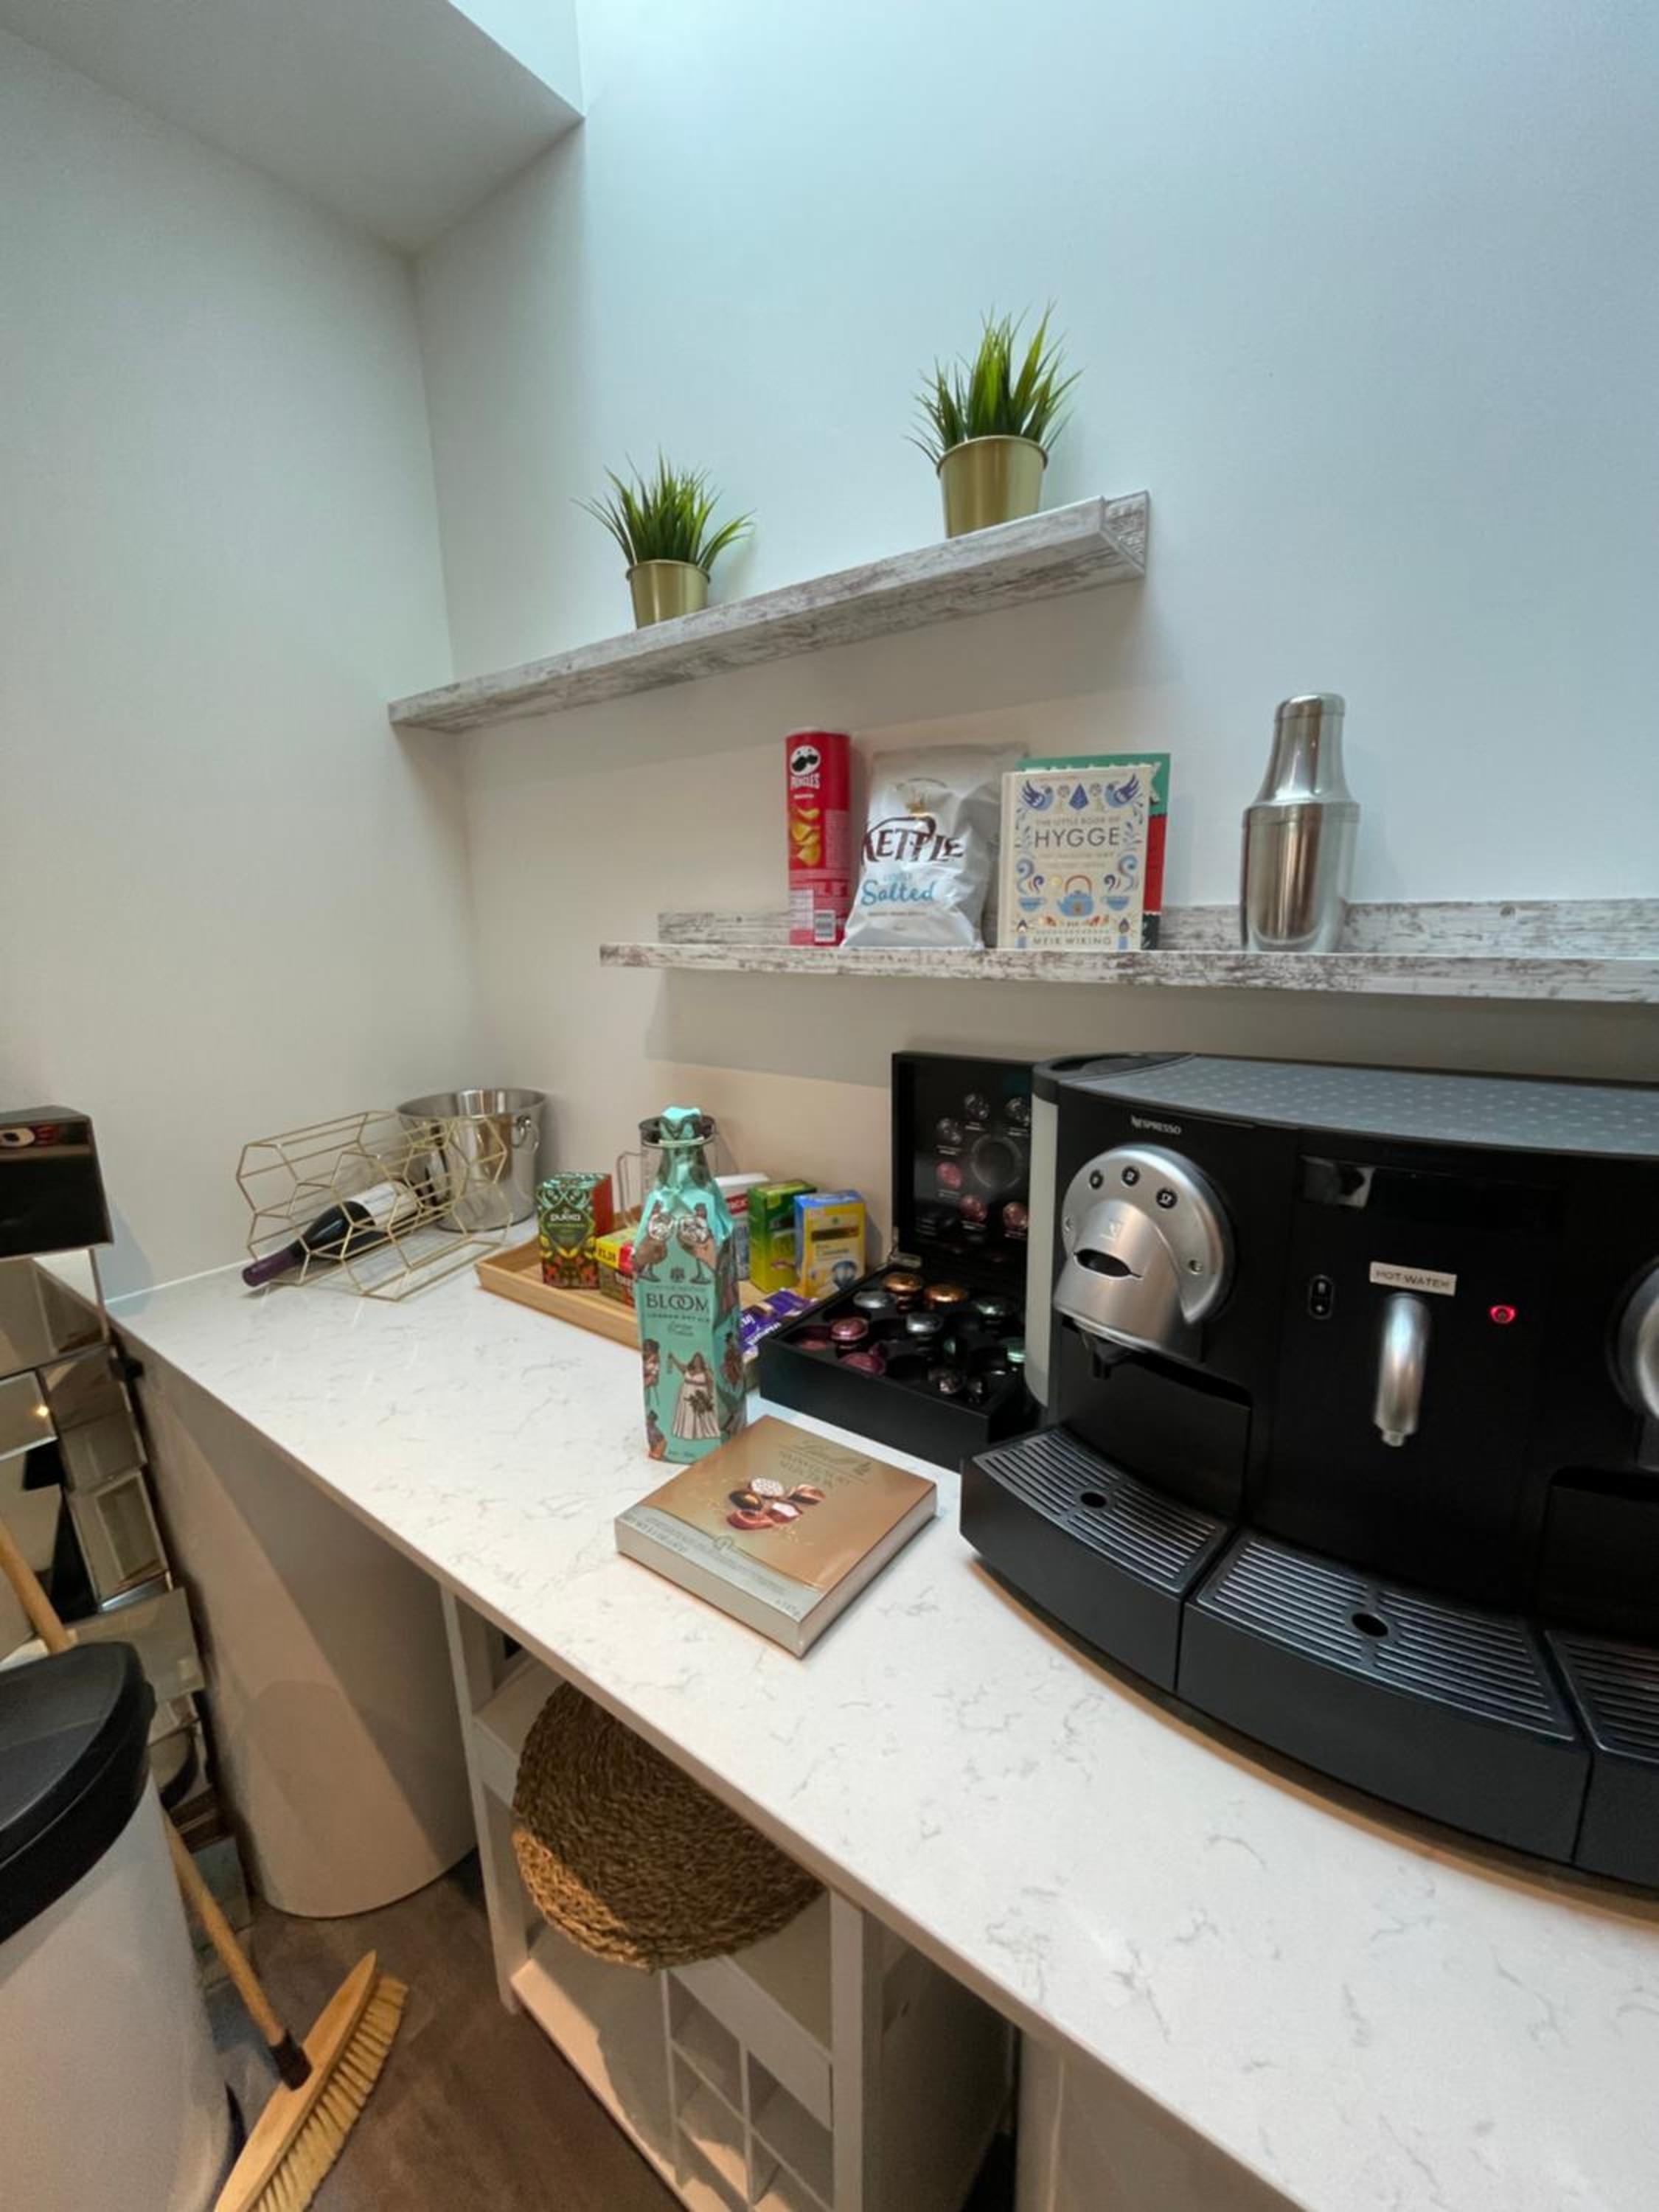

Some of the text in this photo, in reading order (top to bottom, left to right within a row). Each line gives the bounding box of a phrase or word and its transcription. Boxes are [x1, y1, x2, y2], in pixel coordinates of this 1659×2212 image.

[1034, 826, 1121, 848] HYGGE
[860, 879, 939, 906] Salted
[1130, 1114, 1182, 1135] NESPRESSO
[1374, 1269, 1450, 1288] HOT WATER
[645, 1293, 709, 1312] BLOOM
